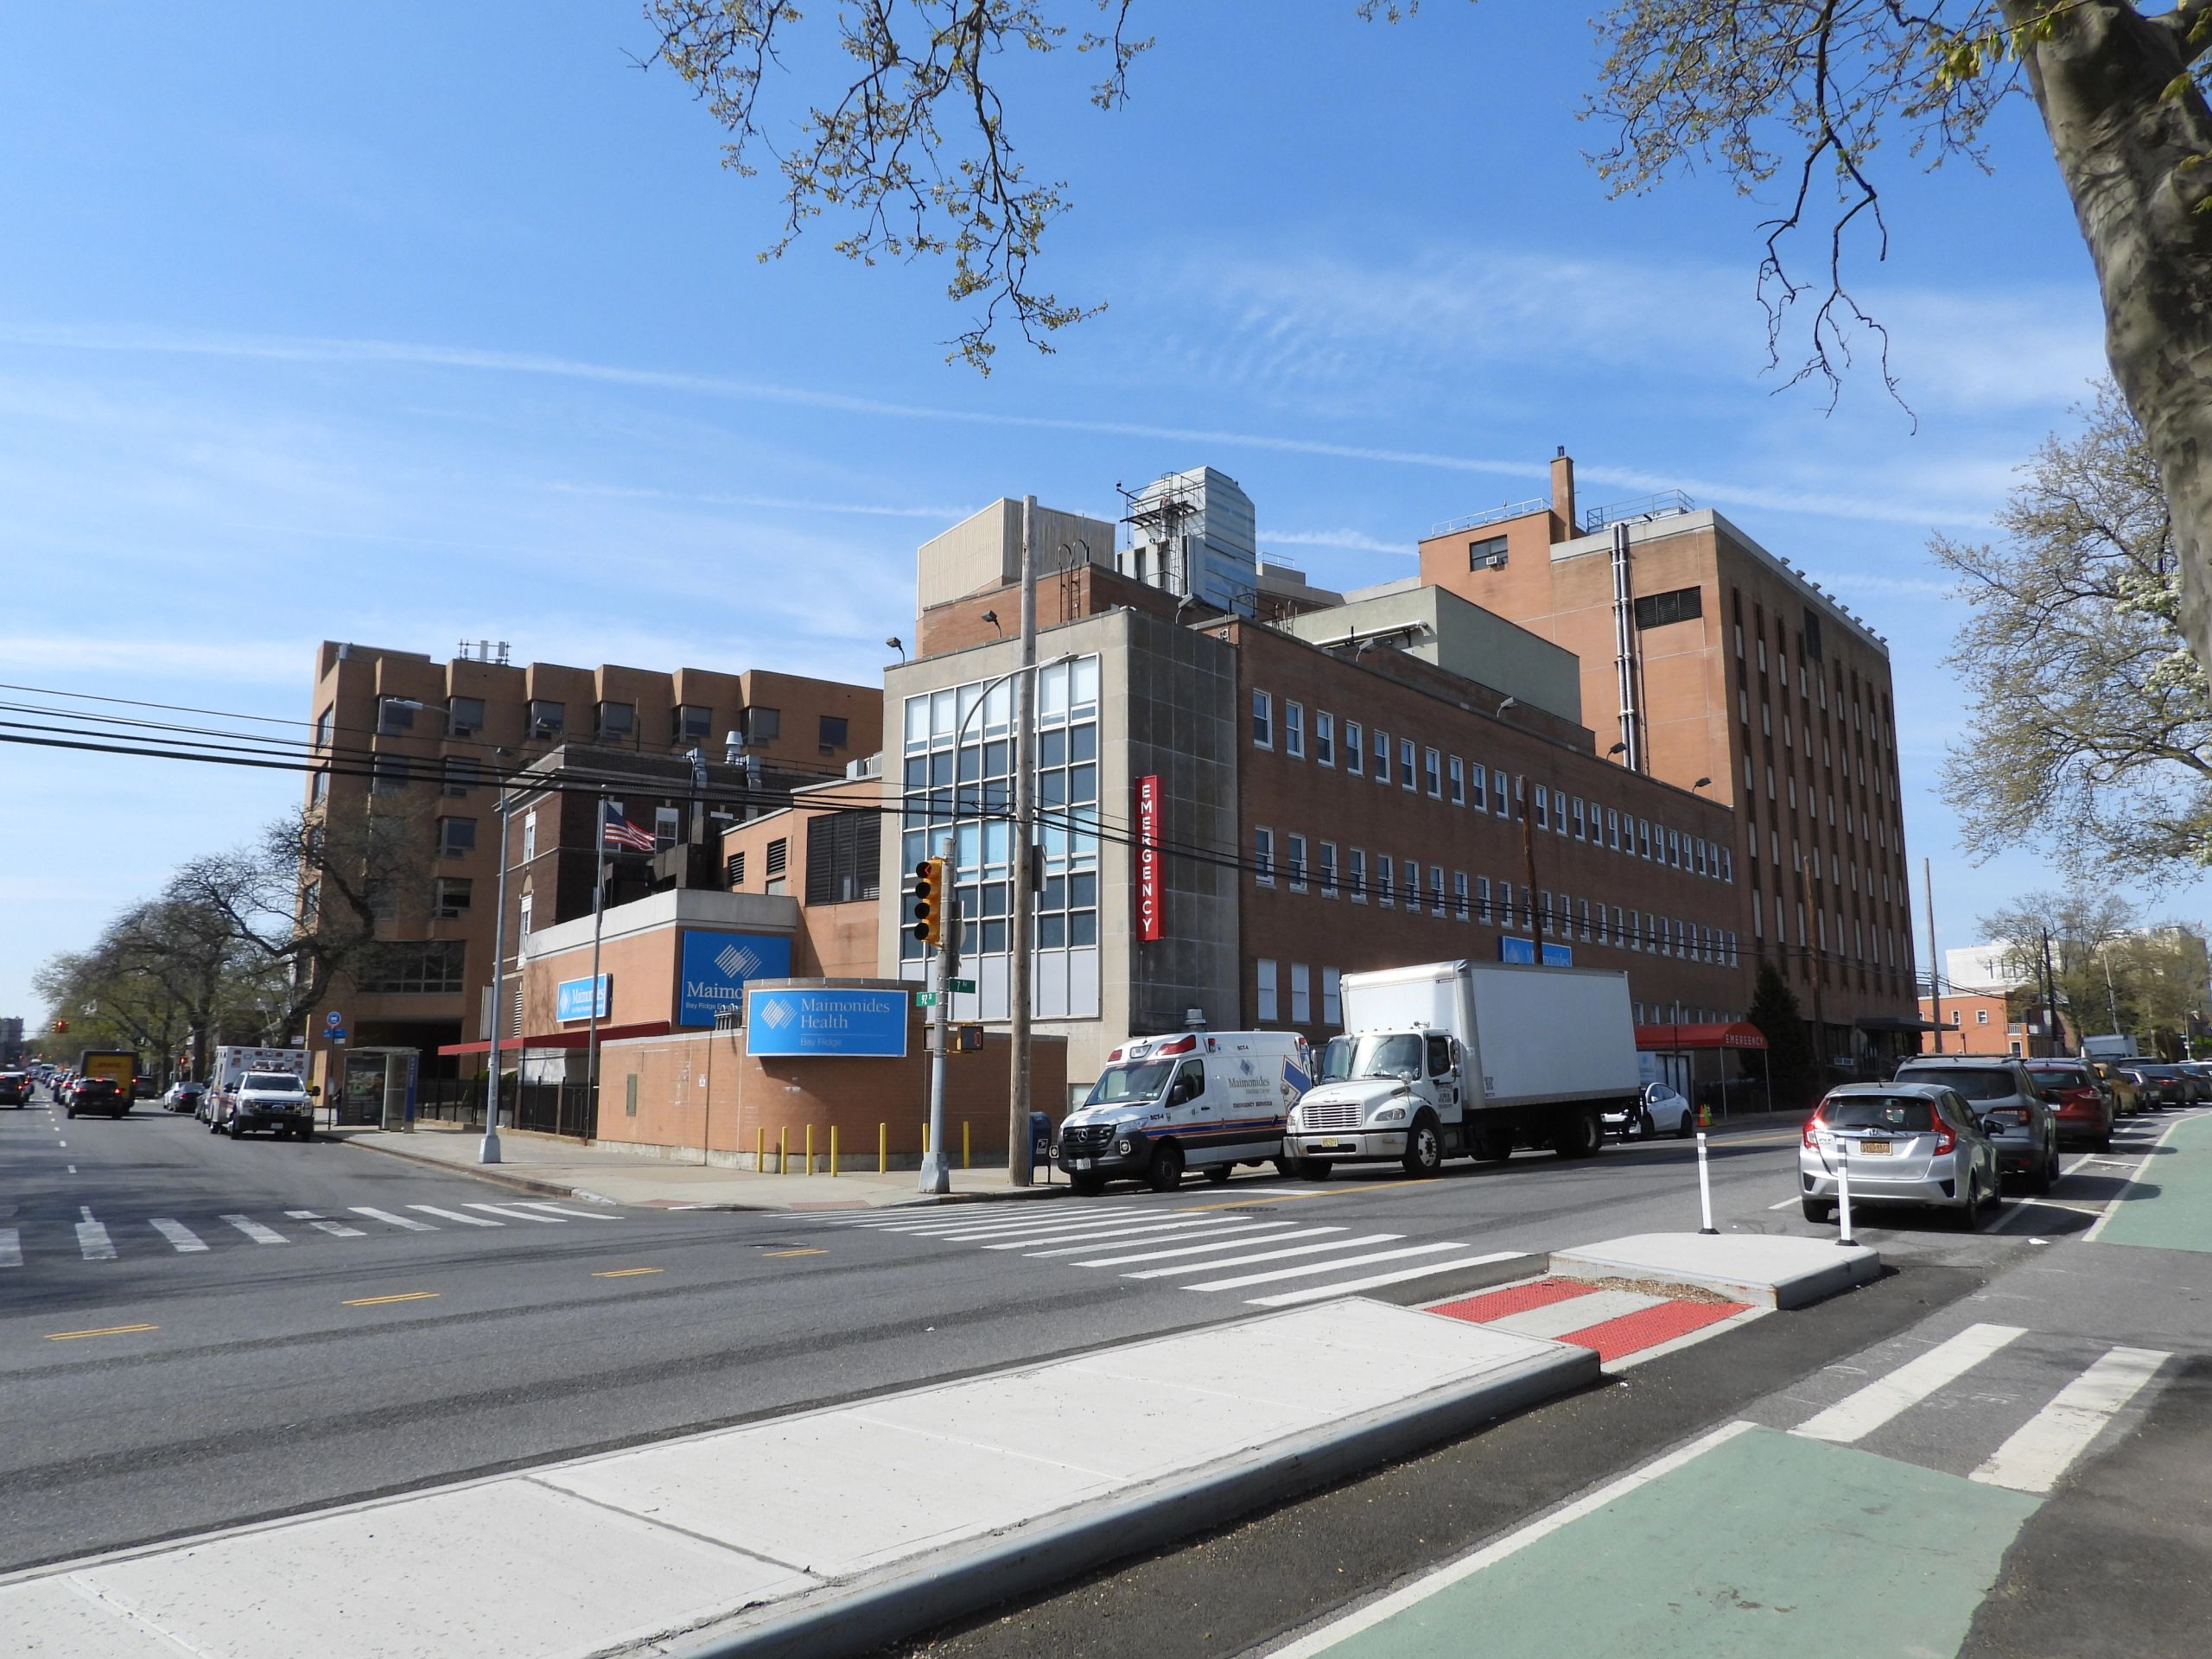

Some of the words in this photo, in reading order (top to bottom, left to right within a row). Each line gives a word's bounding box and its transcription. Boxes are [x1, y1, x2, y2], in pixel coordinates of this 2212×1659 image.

[1141, 784, 1152, 932] EMERGENCY
[686, 982, 743, 999] Maimo
[957, 981, 961, 991] 7
[801, 998, 891, 1013] Maimonides
[921, 995, 928, 1005] 92
[801, 1014, 849, 1028] Health
[800, 1038, 816, 1046] Bay
[817, 1039, 842, 1048] Ridge
[1726, 1034, 1764, 1046] EMERGENCY
[1228, 1076, 1270, 1088] Maimonides
